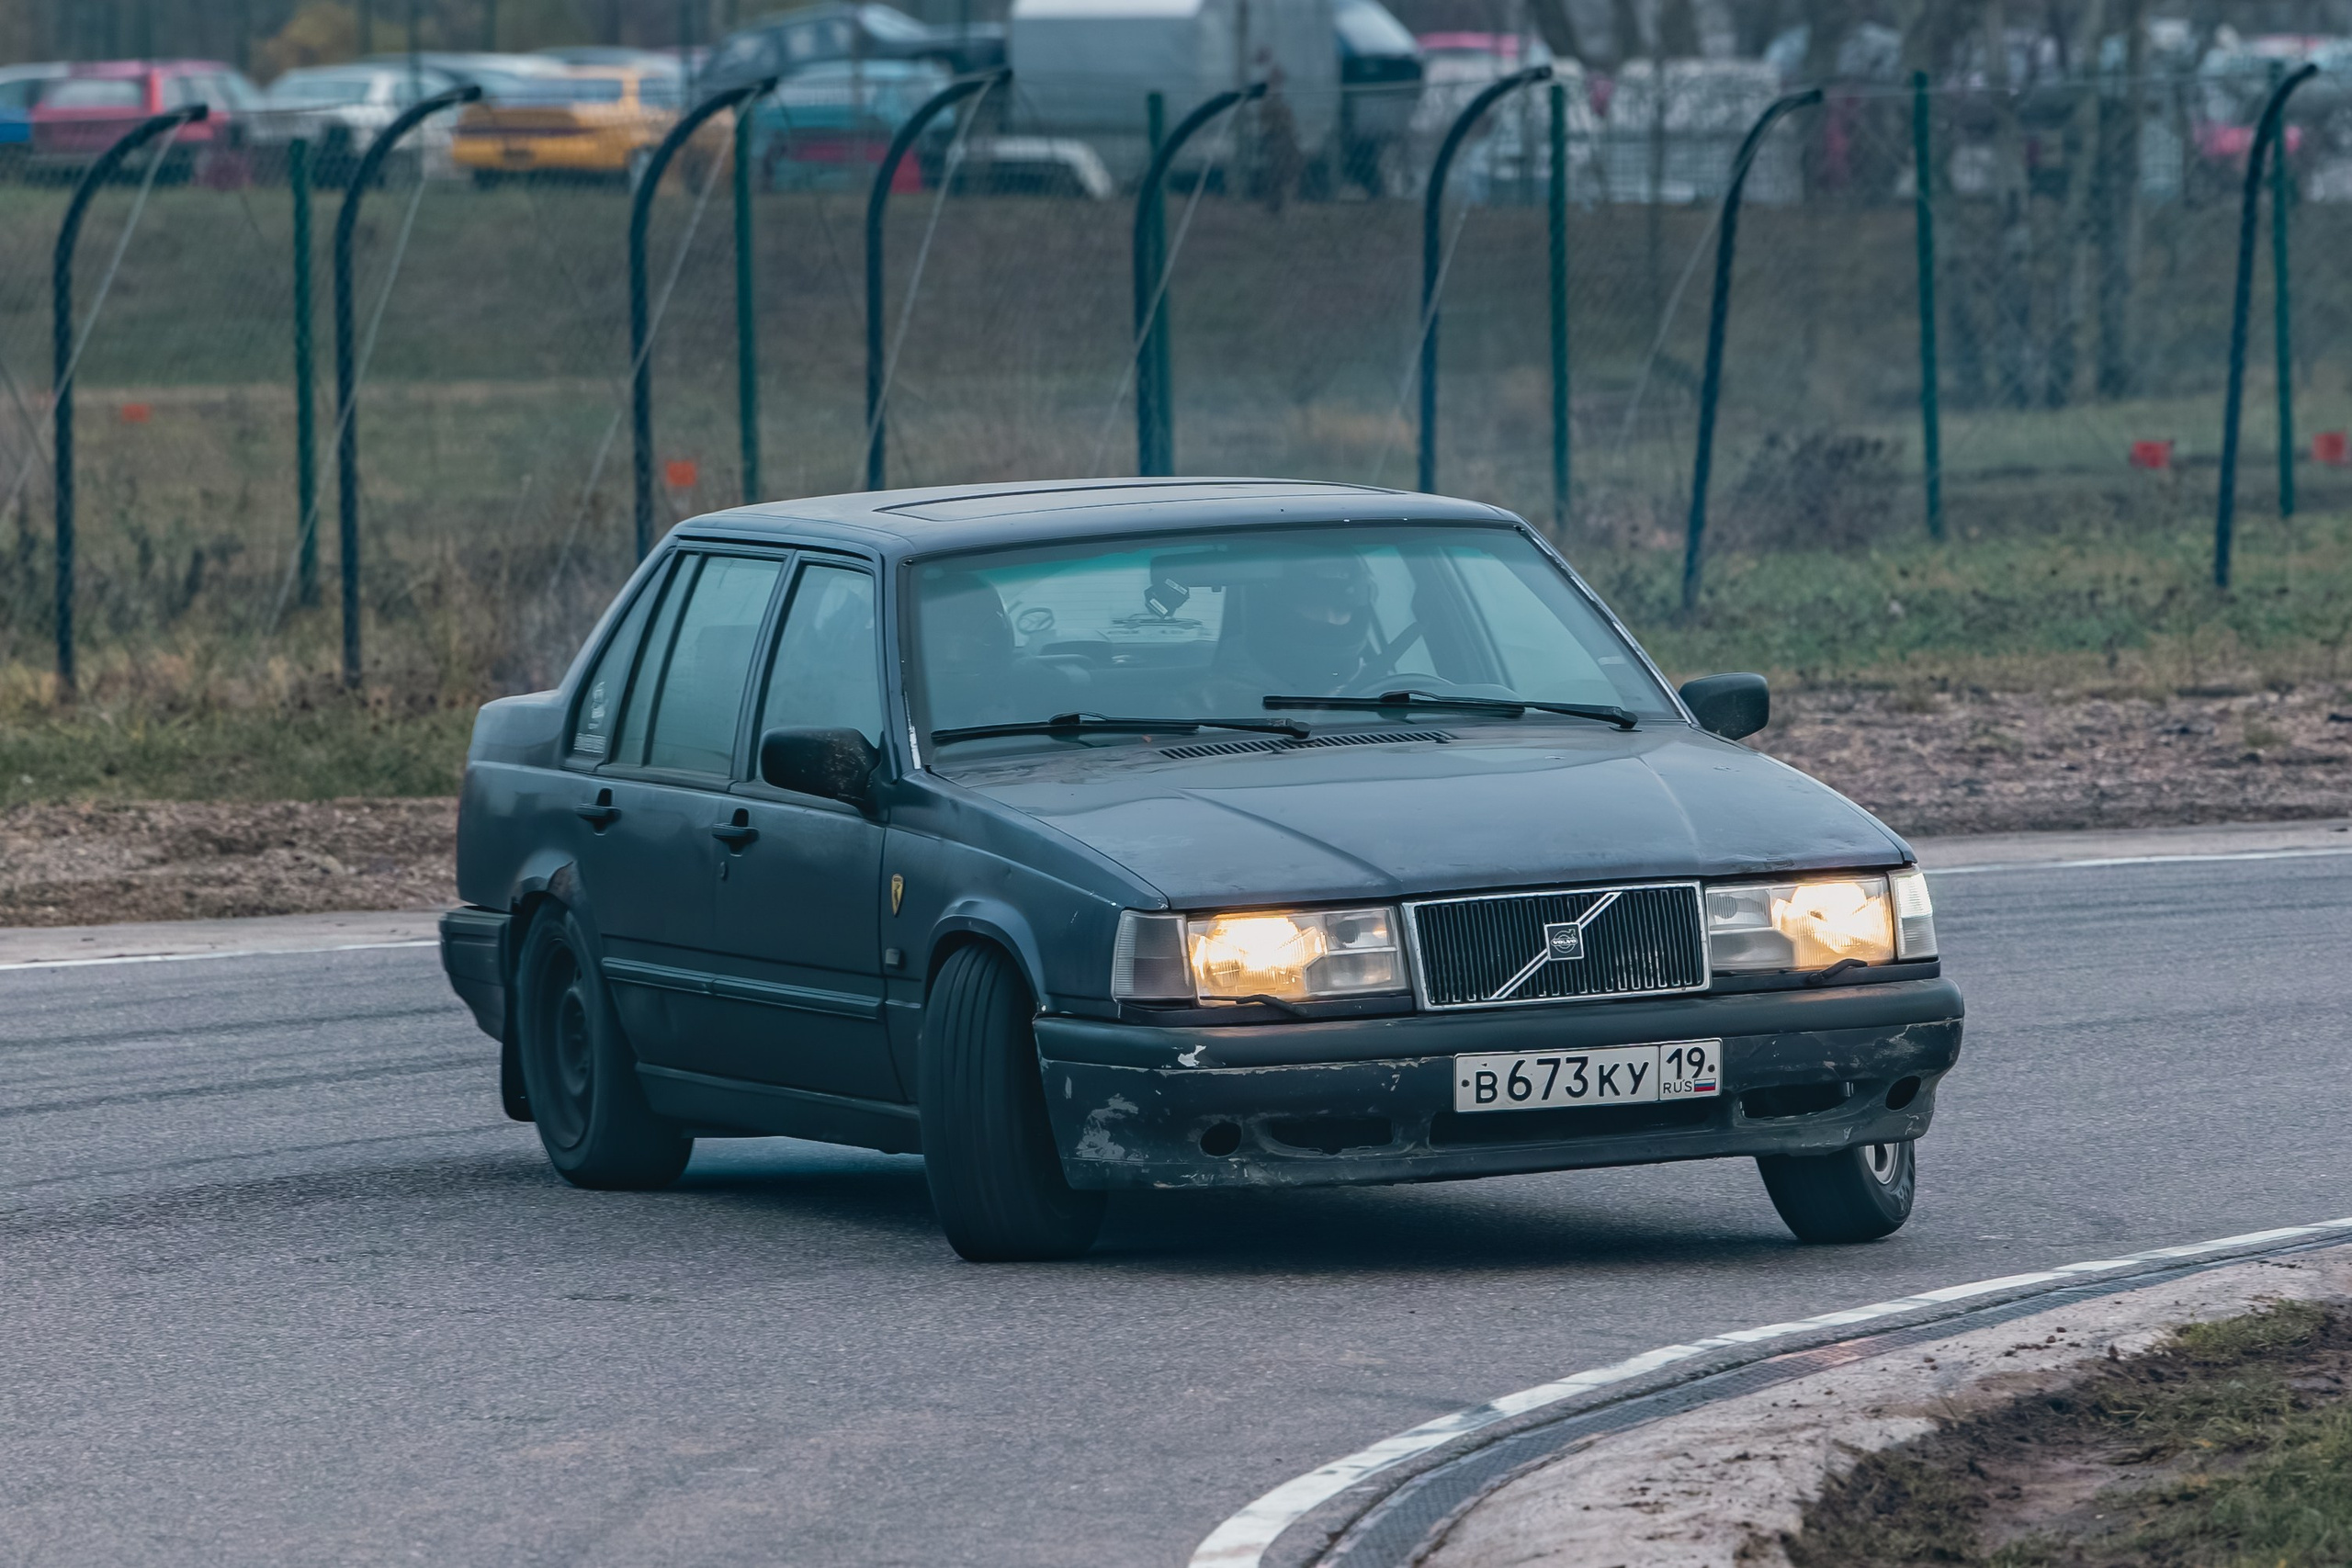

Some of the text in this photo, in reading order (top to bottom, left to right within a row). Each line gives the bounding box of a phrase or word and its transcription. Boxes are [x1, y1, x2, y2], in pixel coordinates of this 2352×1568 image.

[1476, 1046, 1706, 1104] В673КУ 19
[1663, 1079, 1692, 1095] RUS
